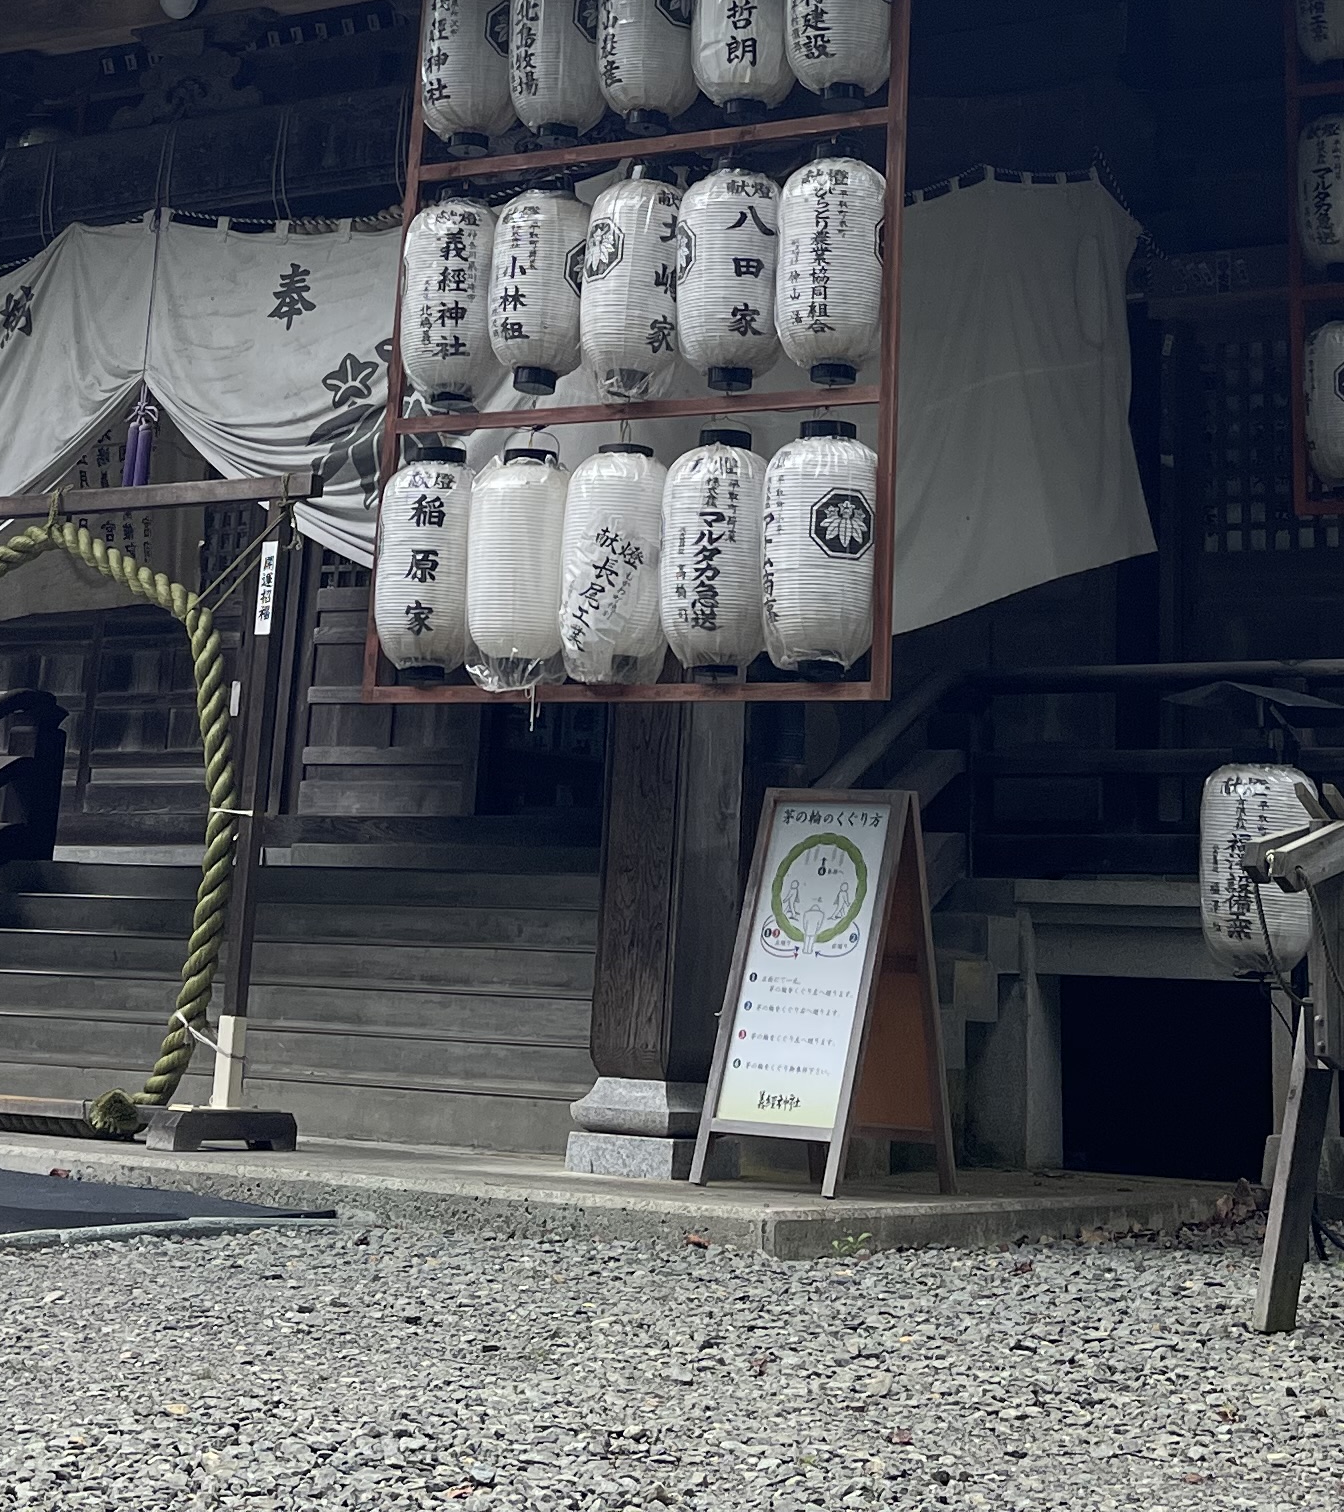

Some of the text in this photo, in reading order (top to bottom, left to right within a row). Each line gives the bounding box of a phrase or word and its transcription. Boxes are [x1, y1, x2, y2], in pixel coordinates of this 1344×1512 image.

[726, 179, 773, 199] 献燈
[267, 262, 317, 331] 奉
[432, 228, 471, 360] 義經神社
[499, 255, 530, 341] 小林組
[725, 205, 776, 337] 八田家
[404, 493, 446, 636] 稲原家
[595, 526, 645, 570] 献燈
[690, 510, 726, 631] マルタカ急送
[565, 555, 619, 652] 長尾工業
[782, 808, 884, 828] 茅の輪のくぐり方
